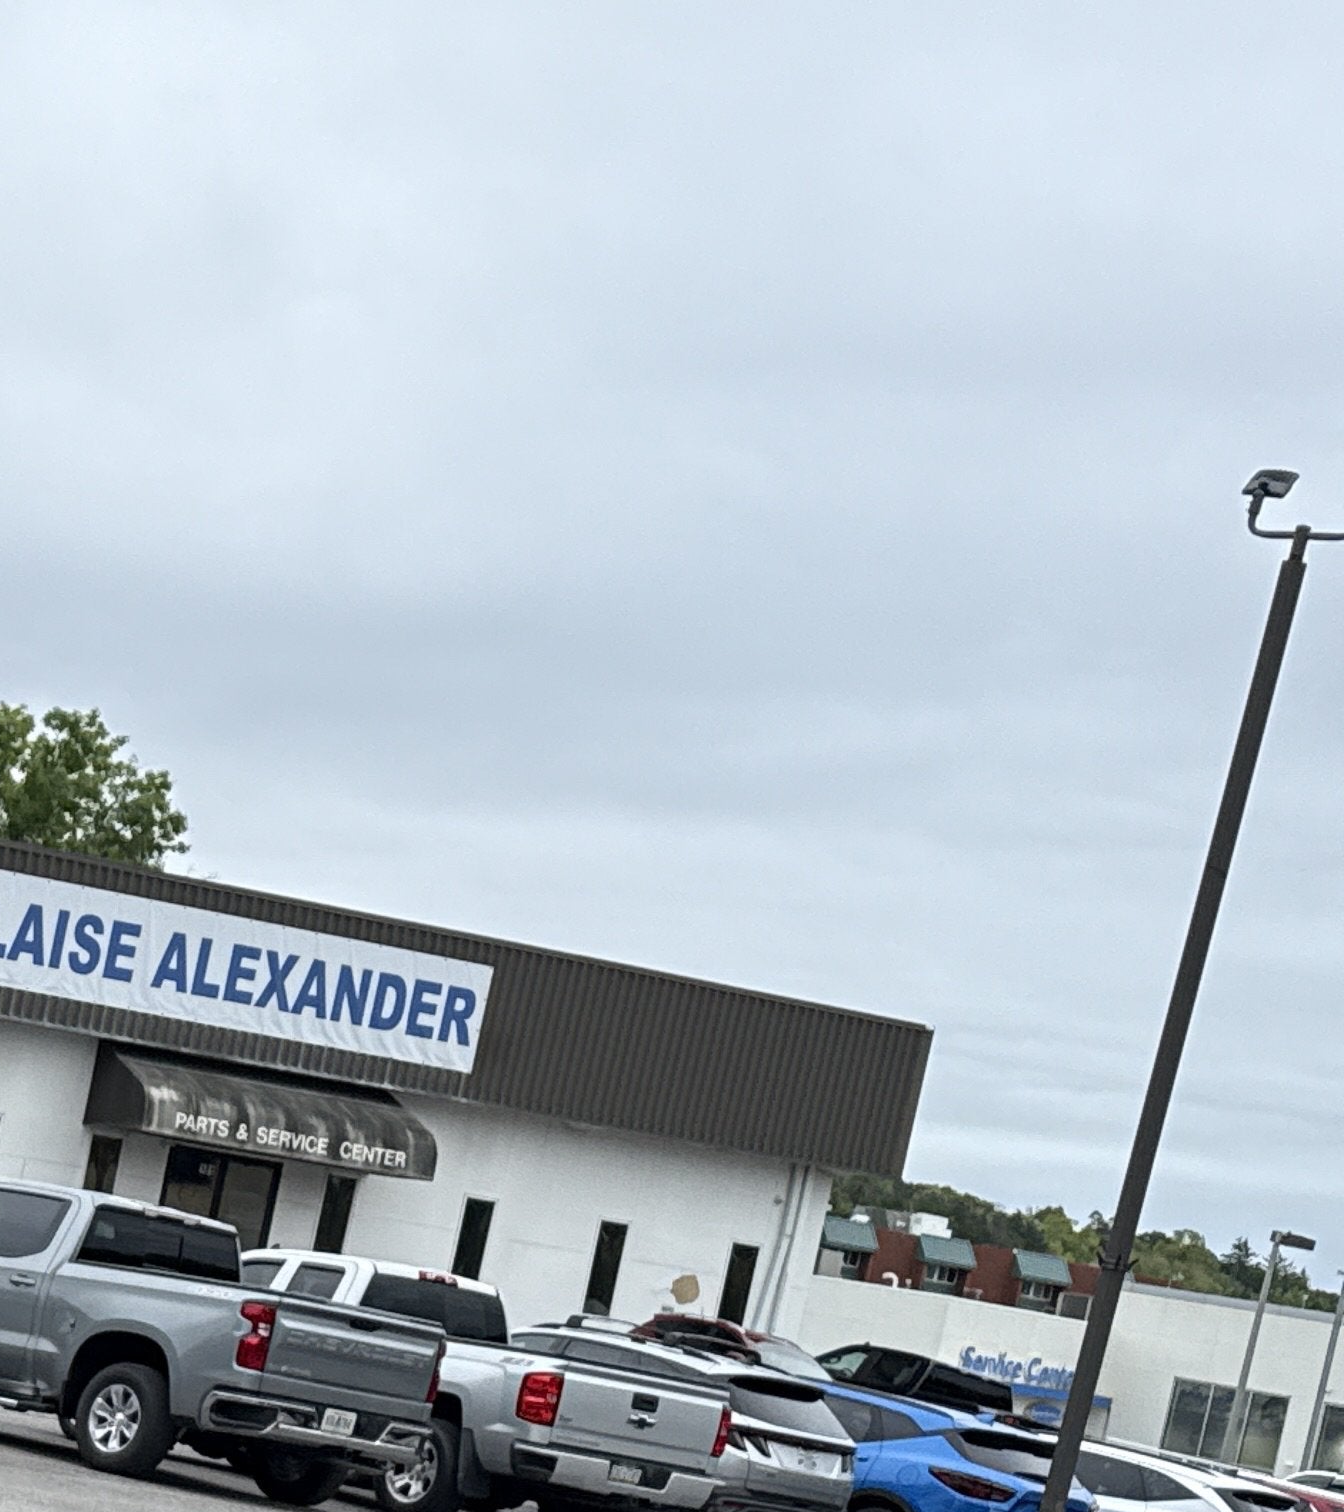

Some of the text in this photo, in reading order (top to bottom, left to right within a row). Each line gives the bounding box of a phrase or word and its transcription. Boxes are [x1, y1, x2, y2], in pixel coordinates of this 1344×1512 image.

[150, 931, 478, 1047] ALEXANDER
[174, 1111, 407, 1169] PARTS & SERVICE CENTER
[960, 1345, 1023, 1380] Service
